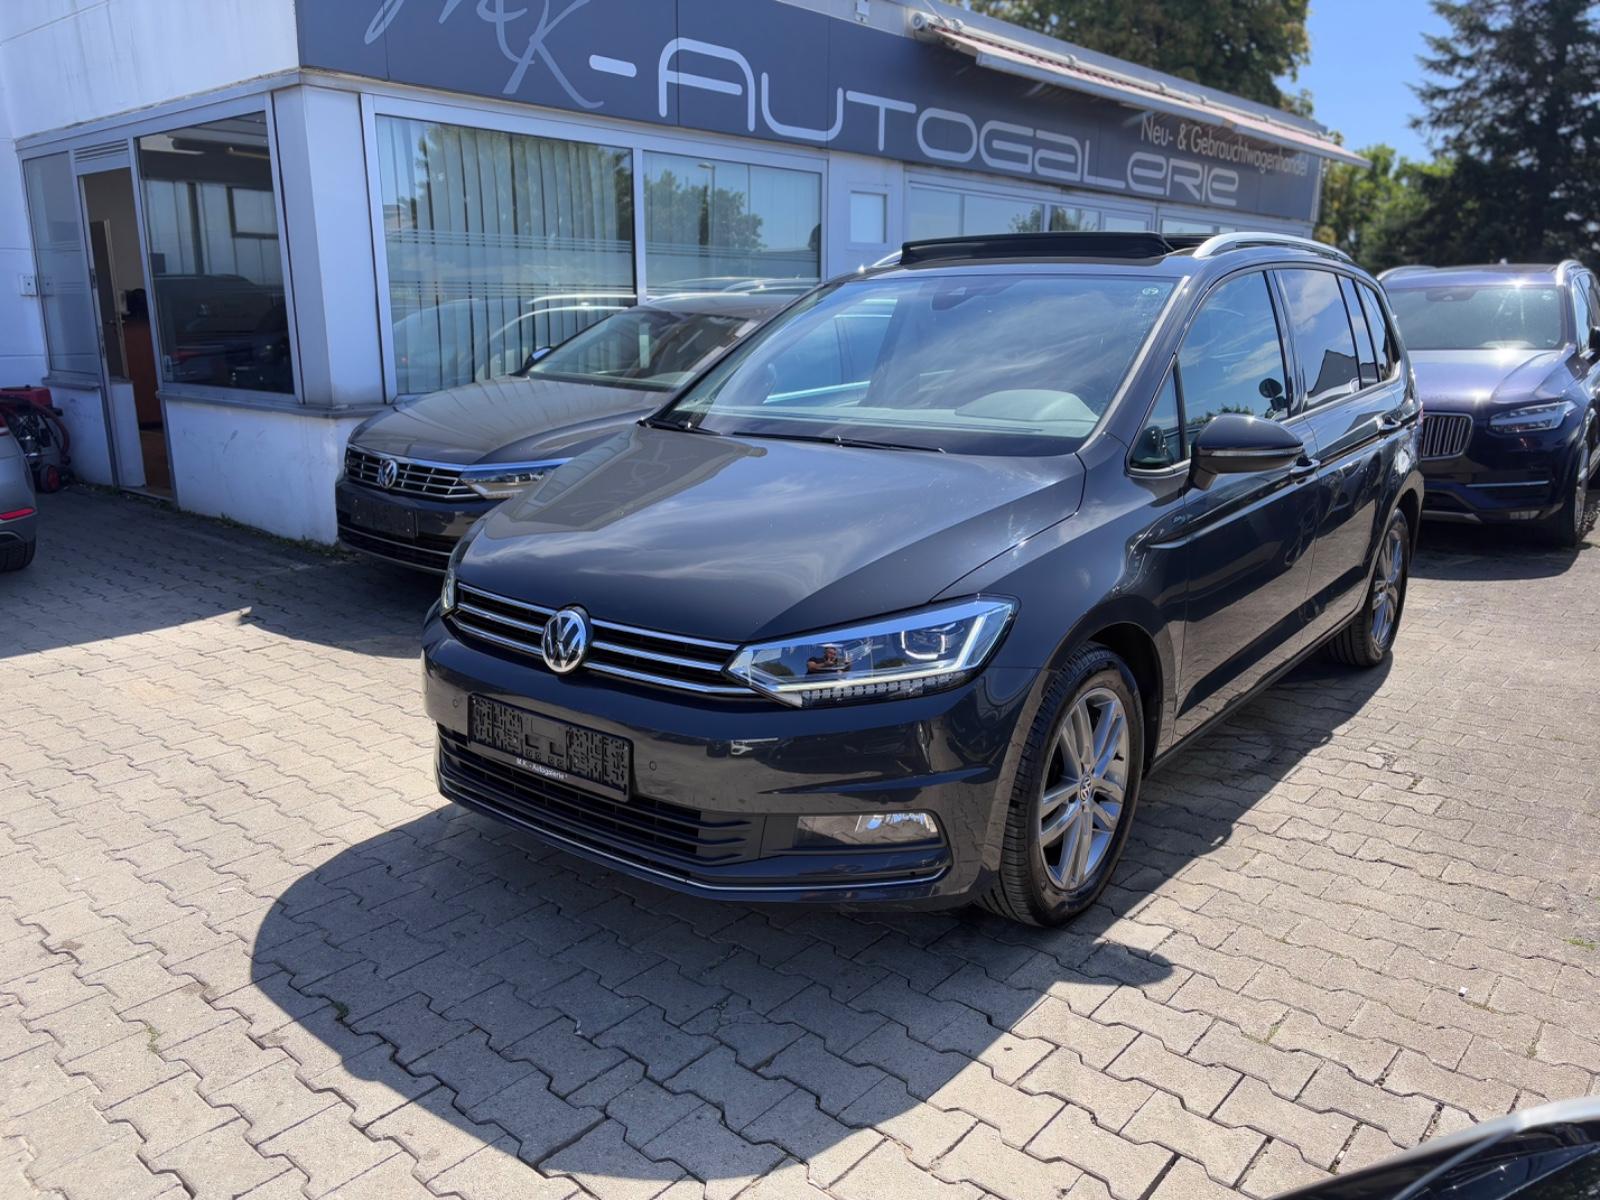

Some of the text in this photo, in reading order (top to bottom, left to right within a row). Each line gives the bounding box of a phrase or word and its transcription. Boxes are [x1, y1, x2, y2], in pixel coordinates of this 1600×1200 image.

[1140, 112, 1174, 147] Neu-
[1176, 123, 1188, 151] &
[542, 610, 586, 672] VW
